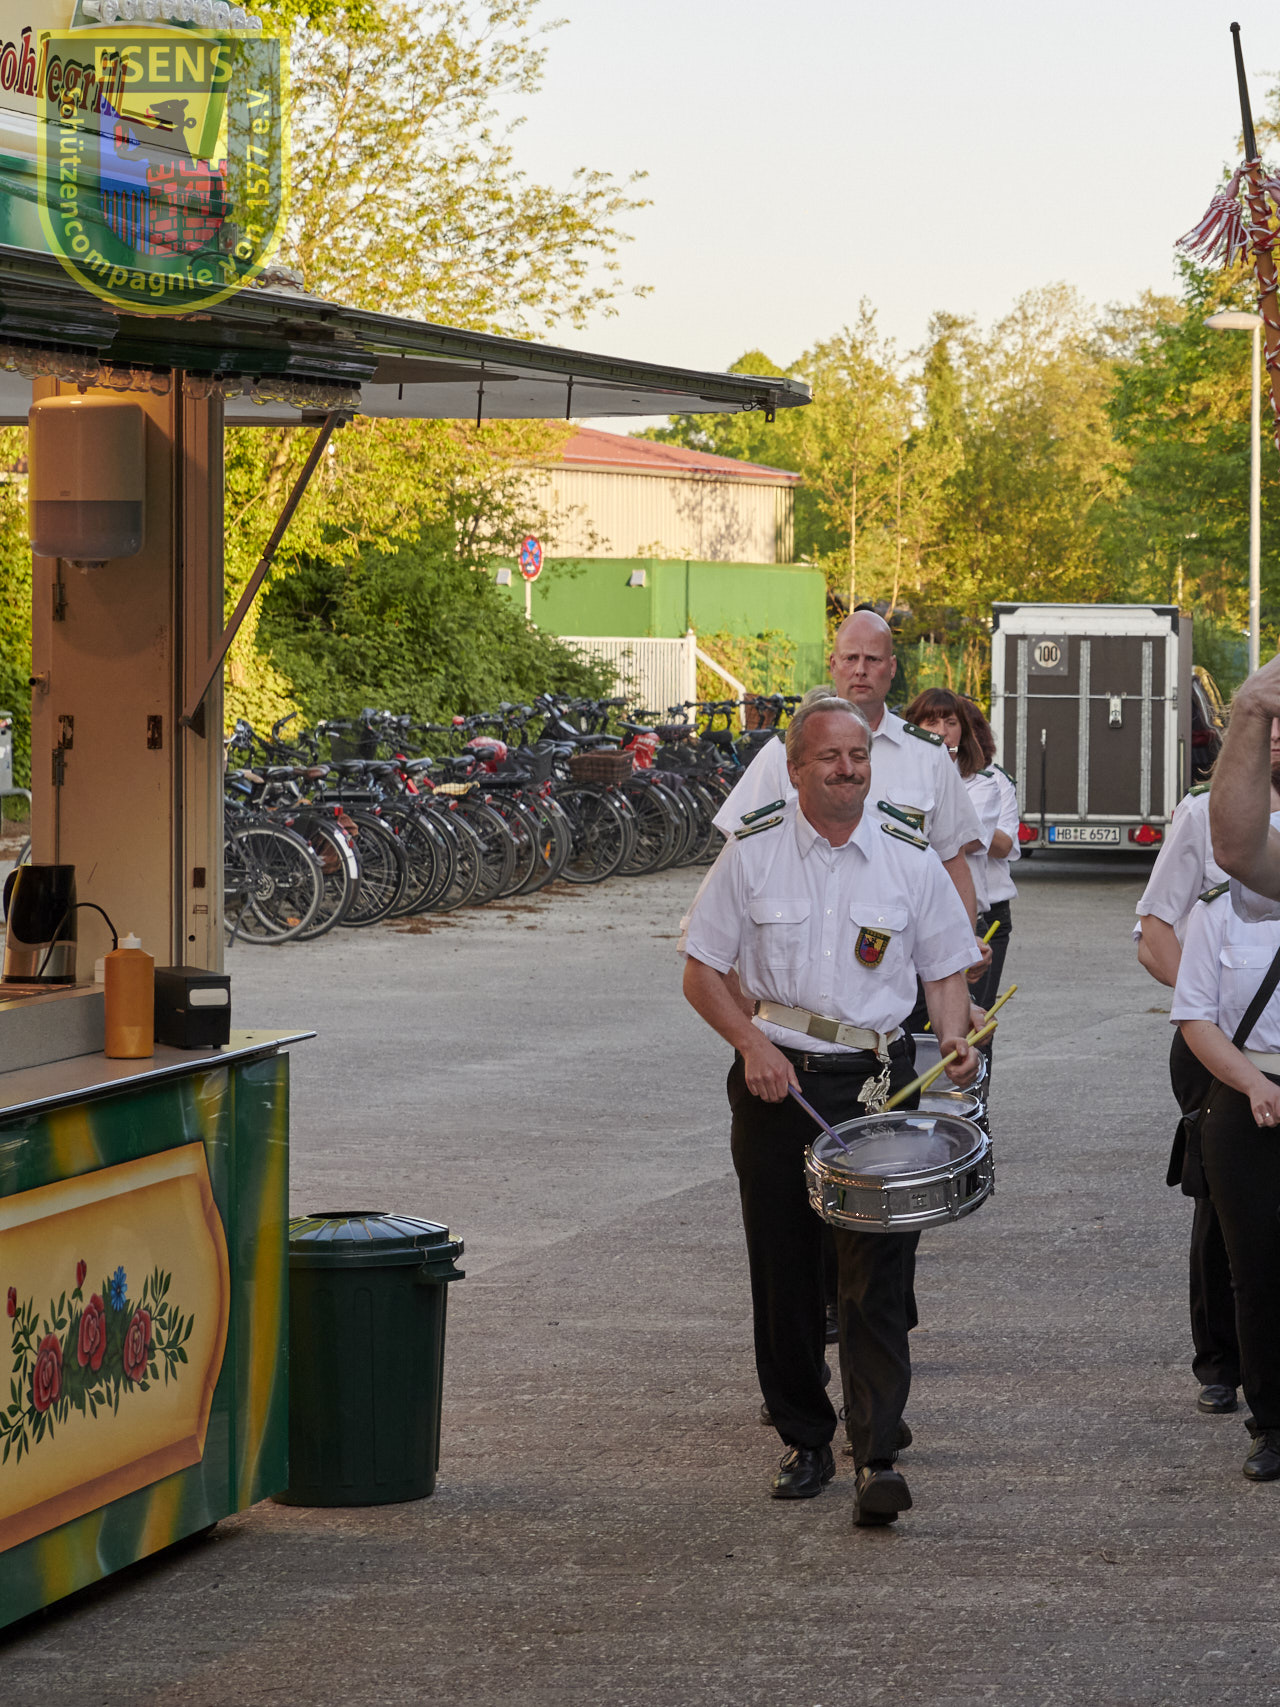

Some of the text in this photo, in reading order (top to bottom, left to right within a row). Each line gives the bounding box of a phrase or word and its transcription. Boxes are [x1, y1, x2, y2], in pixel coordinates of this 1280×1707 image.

[0, 26, 129, 119] ohlegrill
[1036, 645, 1057, 662] 100
[1056, 828, 1072, 840] HB
[1089, 829, 1118, 841] 6571
